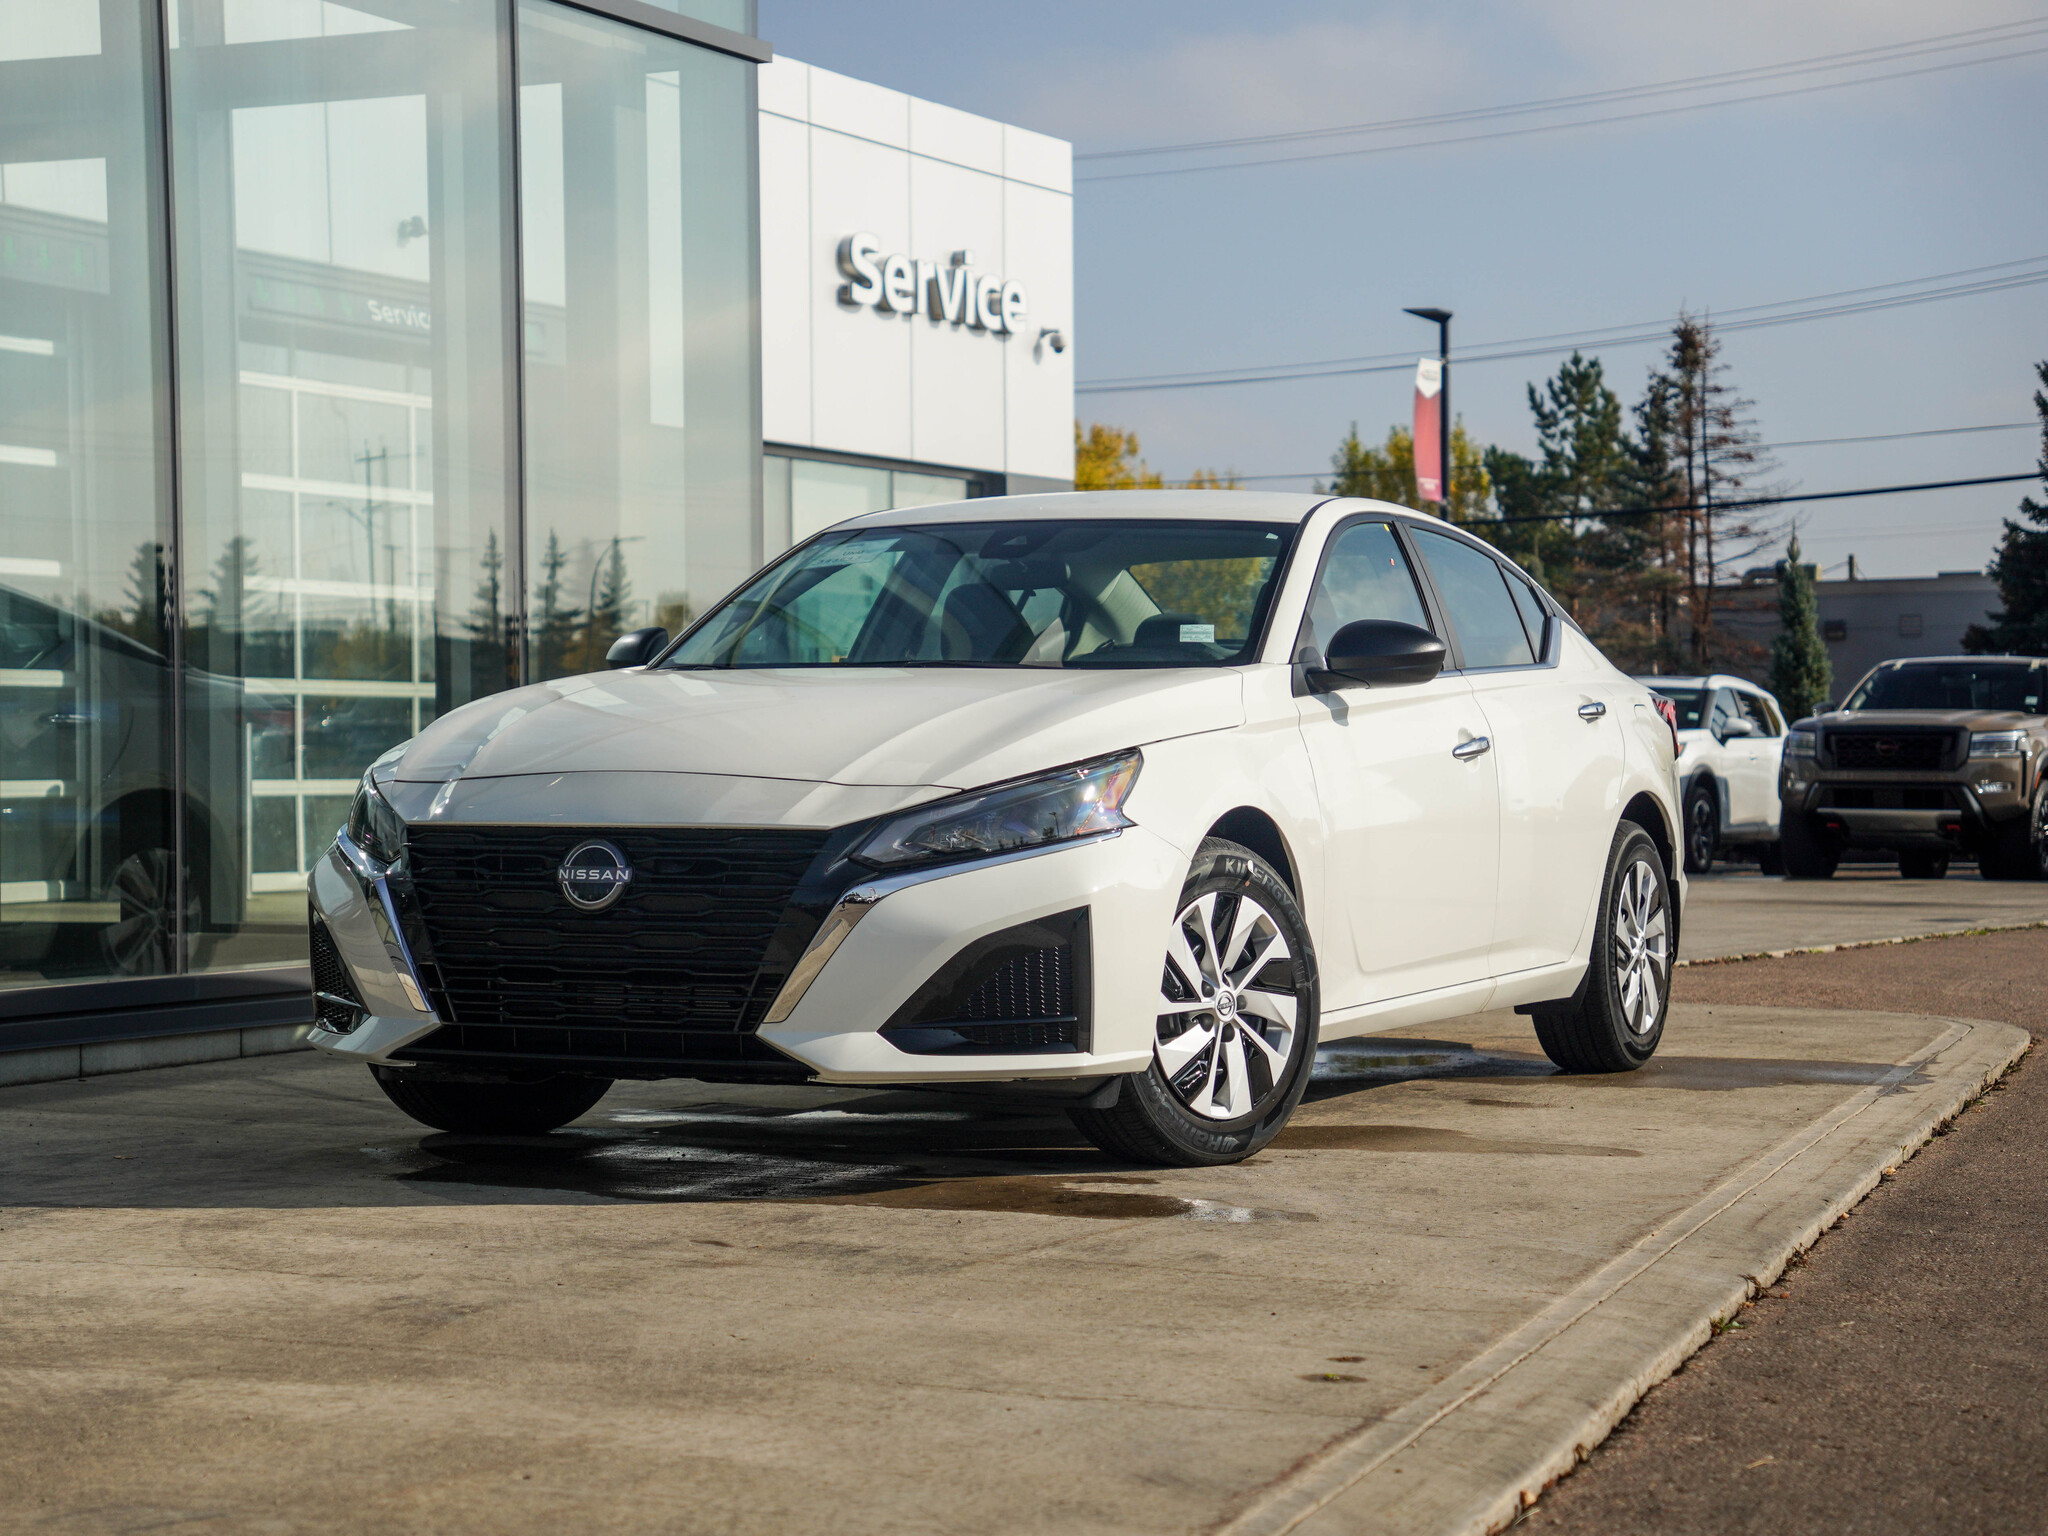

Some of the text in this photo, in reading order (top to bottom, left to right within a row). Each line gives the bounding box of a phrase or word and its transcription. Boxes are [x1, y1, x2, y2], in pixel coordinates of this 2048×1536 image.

[839, 231, 1028, 334] Service
[367, 299, 431, 330] Servic
[559, 869, 629, 880] NISSAN
